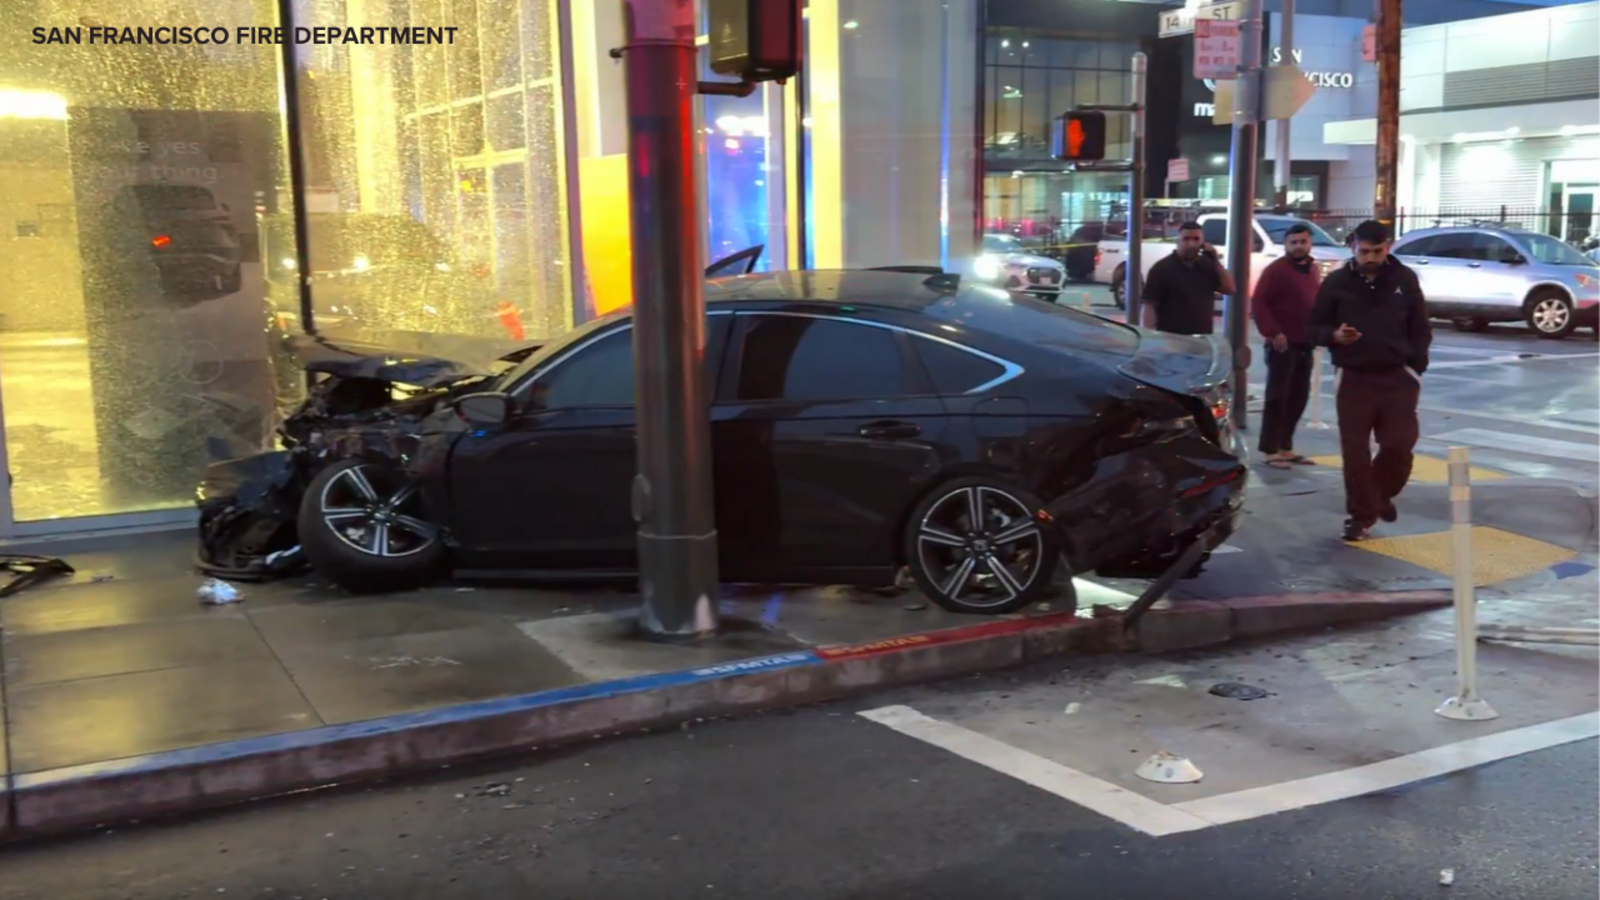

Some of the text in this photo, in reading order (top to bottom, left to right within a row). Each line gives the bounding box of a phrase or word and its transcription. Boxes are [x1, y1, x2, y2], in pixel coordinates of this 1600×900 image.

[1212, 6, 1231, 20] ST
[1273, 47, 1302, 64] SN
[1304, 71, 1353, 88] CISCO
[158, 141, 200, 158] yes
